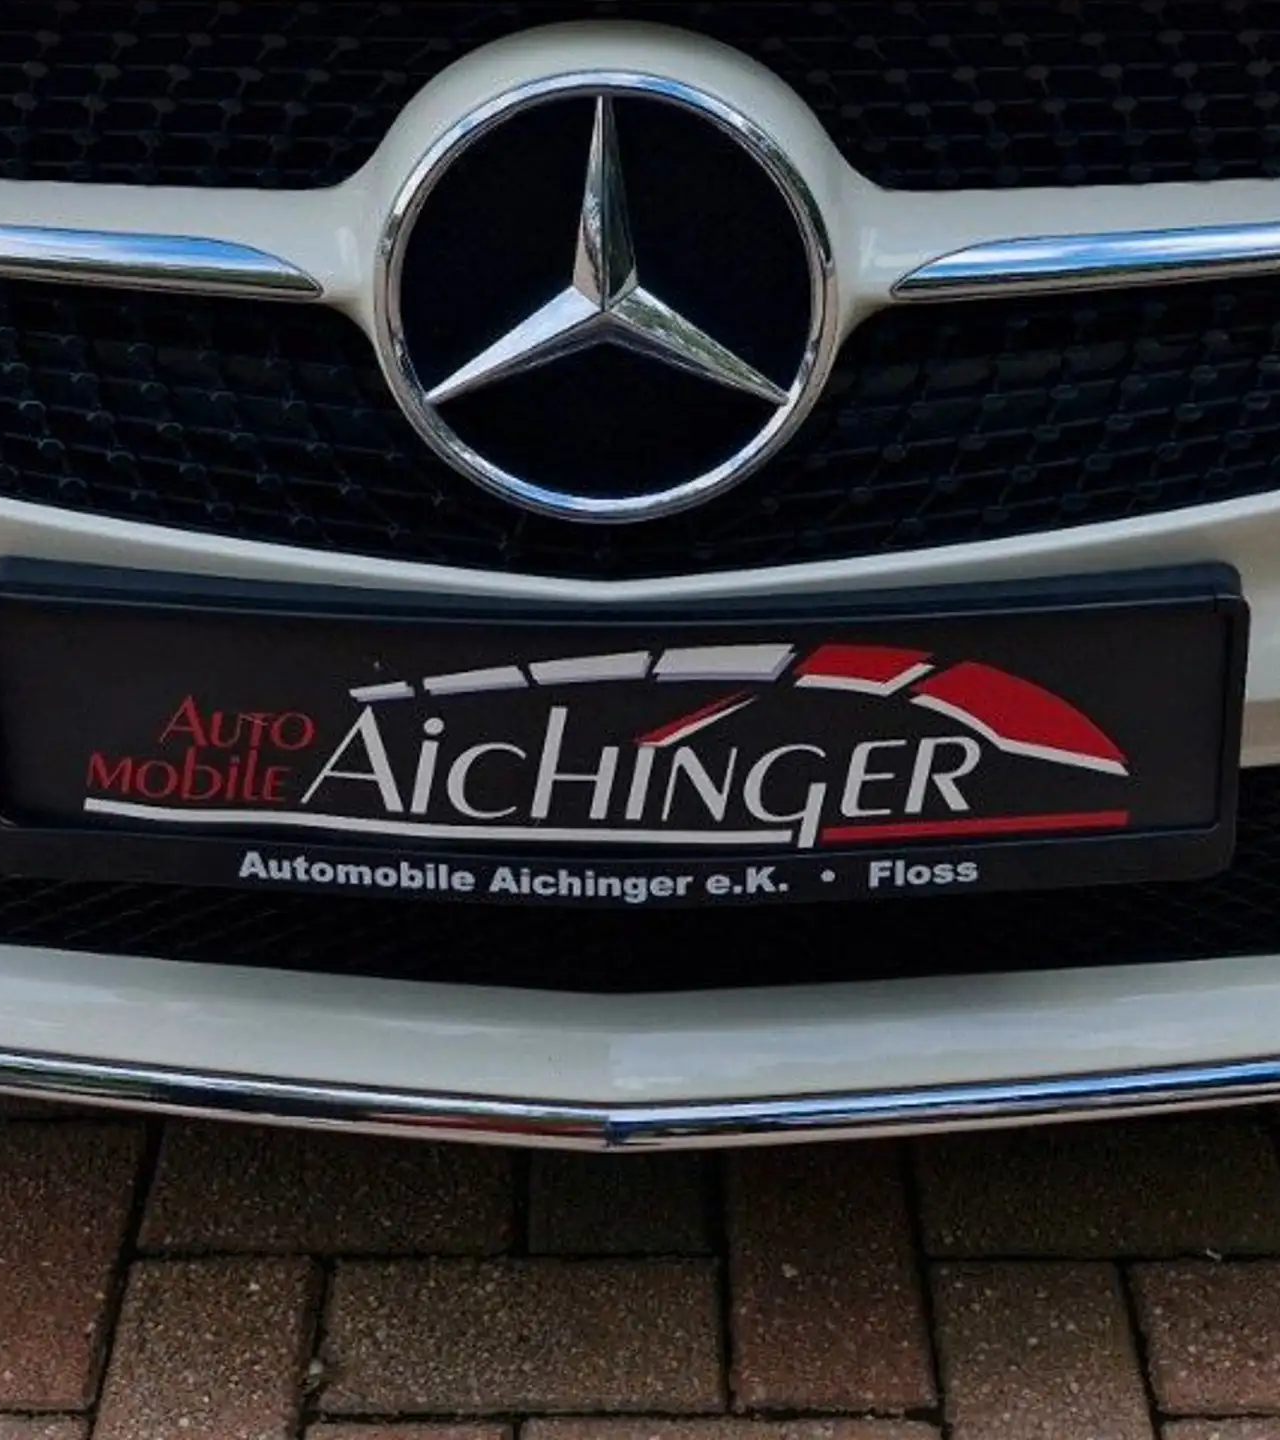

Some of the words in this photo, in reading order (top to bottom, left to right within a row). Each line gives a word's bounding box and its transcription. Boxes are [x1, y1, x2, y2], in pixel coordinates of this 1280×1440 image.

[239, 851, 476, 891] Automobile
[489, 867, 693, 903] Aichinger
[705, 866, 790, 895] e.K.
[869, 861, 979, 889] Floss
